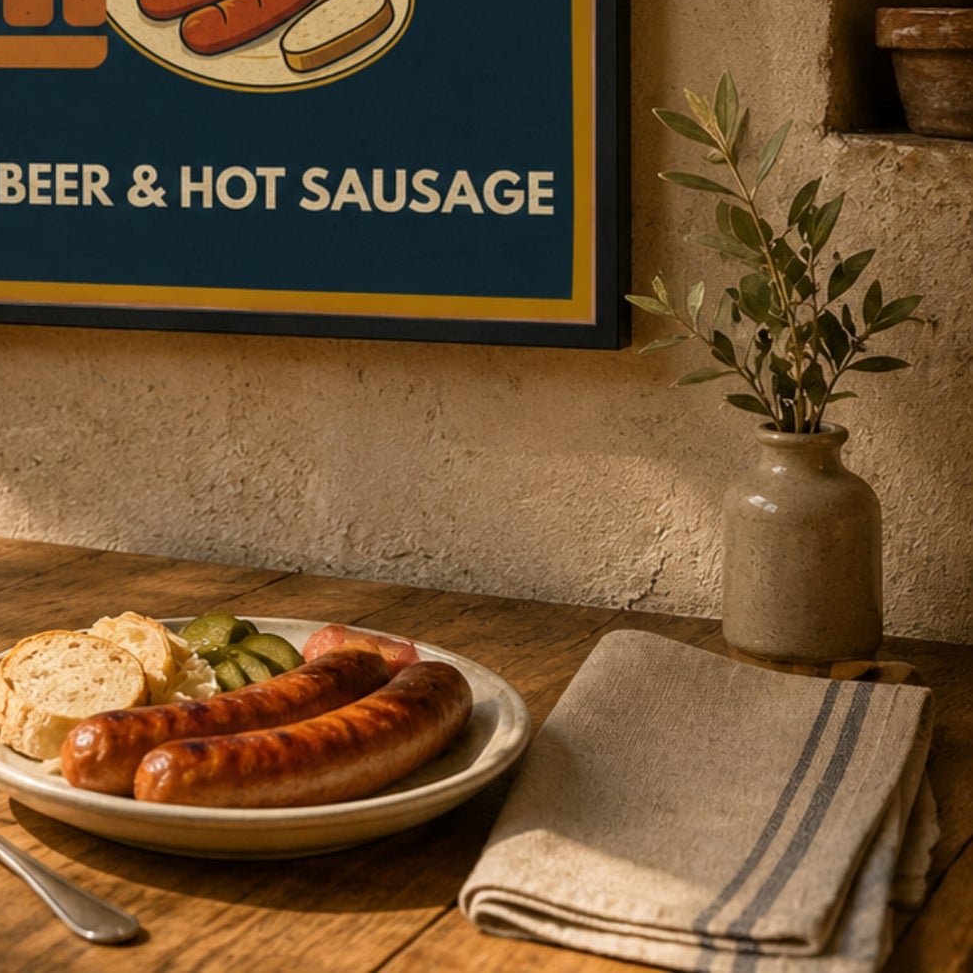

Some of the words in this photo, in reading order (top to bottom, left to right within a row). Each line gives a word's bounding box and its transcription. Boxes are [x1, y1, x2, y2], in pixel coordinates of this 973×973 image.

[127, 164, 168, 208] &
[181, 165, 286, 210] HOT
[300, 166, 554, 215] SAUSAGE
